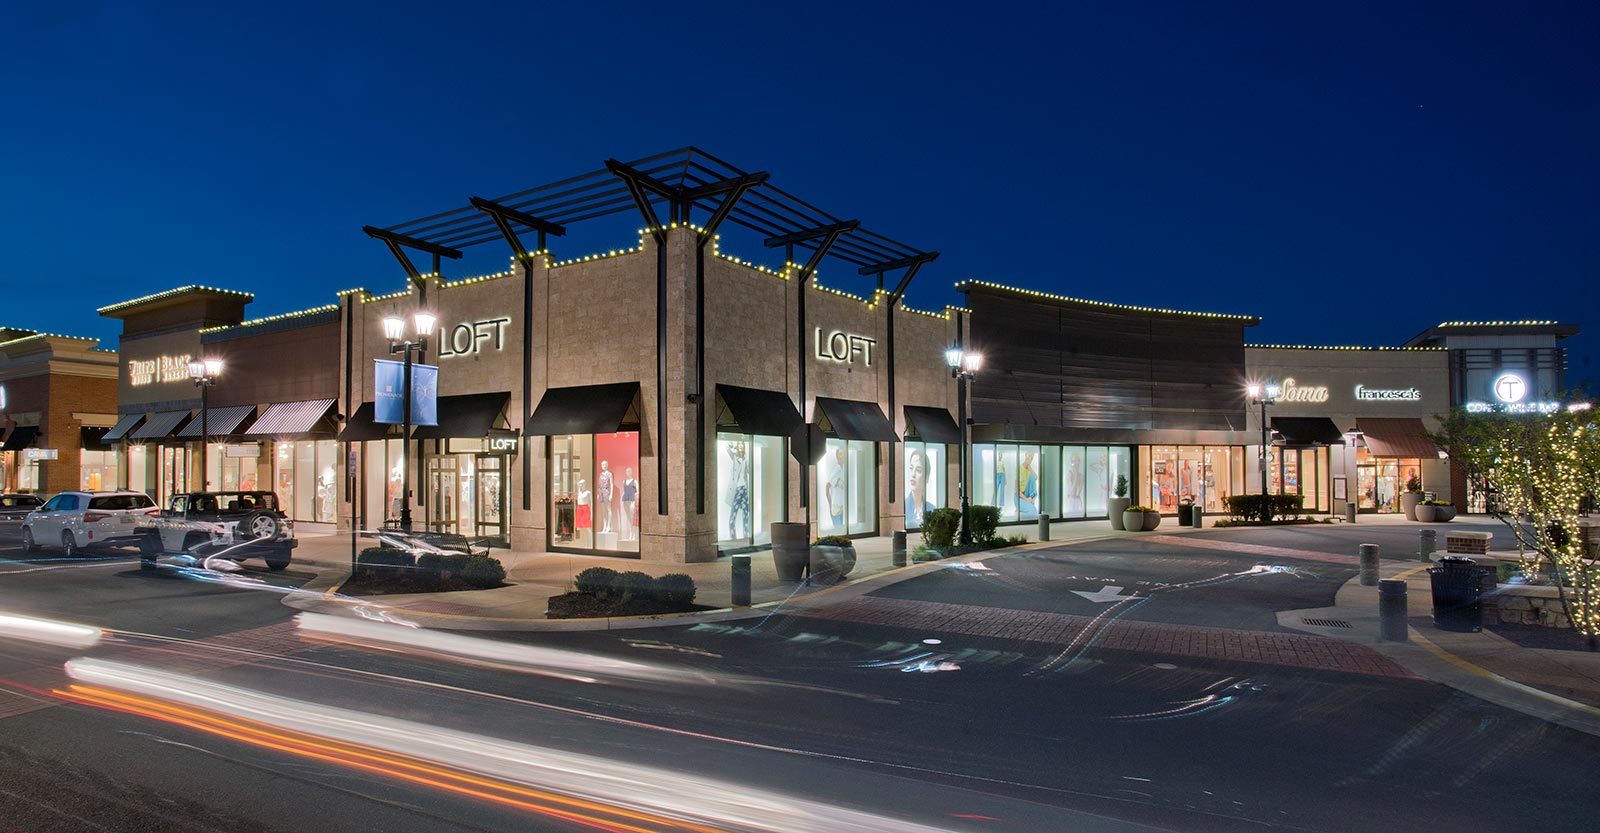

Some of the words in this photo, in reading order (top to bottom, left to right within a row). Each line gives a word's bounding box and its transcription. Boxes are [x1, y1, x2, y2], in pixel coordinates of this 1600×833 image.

[438, 317, 511, 358] LOFT
[815, 327, 877, 368] LOFT
[1278, 377, 1329, 402] Soma
[1355, 384, 1422, 400] francesca's
[491, 438, 517, 450] LOFT
